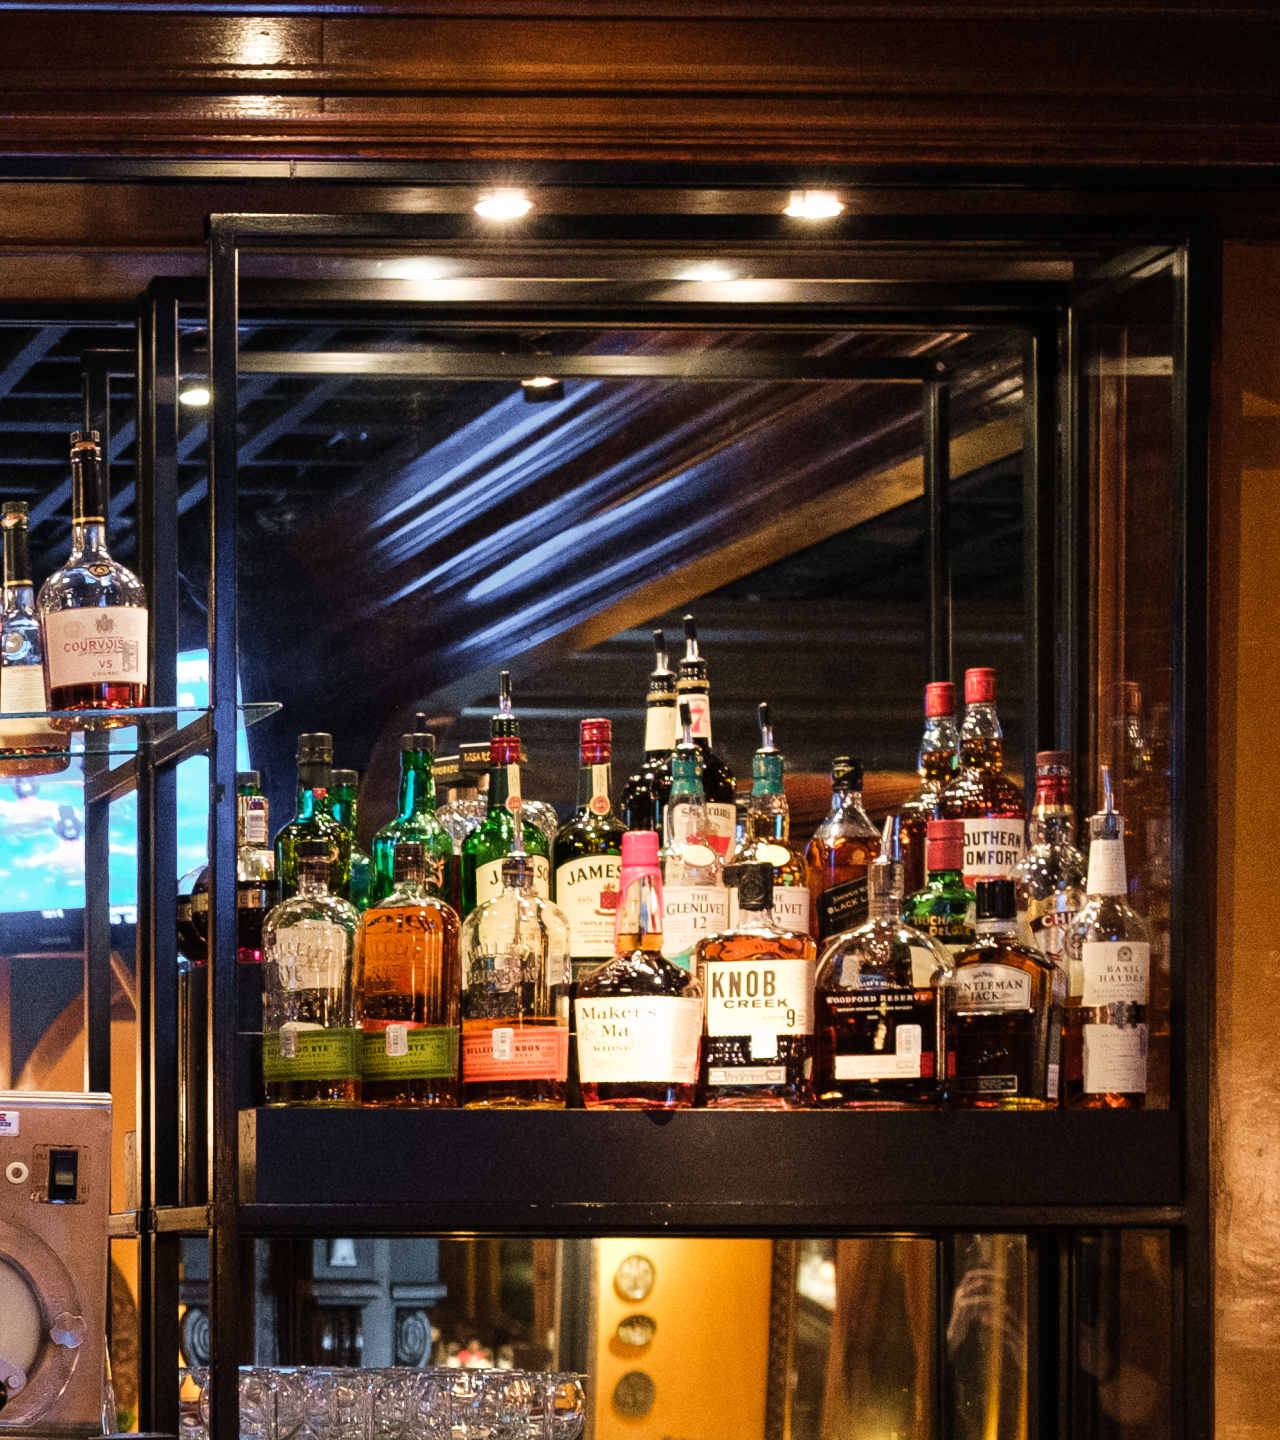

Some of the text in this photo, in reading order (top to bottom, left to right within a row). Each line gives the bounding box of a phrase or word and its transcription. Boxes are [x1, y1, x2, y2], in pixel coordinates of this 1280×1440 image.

[63, 638, 125, 653] COURVOIS
[98, 660, 113, 669] VS
[963, 831, 1022, 848] OUTHERN
[966, 850, 1019, 866] OMFORT
[566, 863, 622, 887] JAMES
[666, 903, 725, 916] GLENLIVET
[774, 904, 802, 916] LIVET
[827, 900, 859, 914] BLACK
[692, 917, 707, 929] 12
[1041, 911, 1073, 928] CHI
[711, 970, 777, 998] KNOB
[954, 979, 1024, 992] ENTLEMAN
[825, 993, 929, 1005] WOODFORD RESERVE
[970, 990, 1000, 1001] JACK
[723, 999, 789, 1009] CREEK
[581, 1006, 657, 1020] Makers
[786, 1008, 796, 1028] 9
